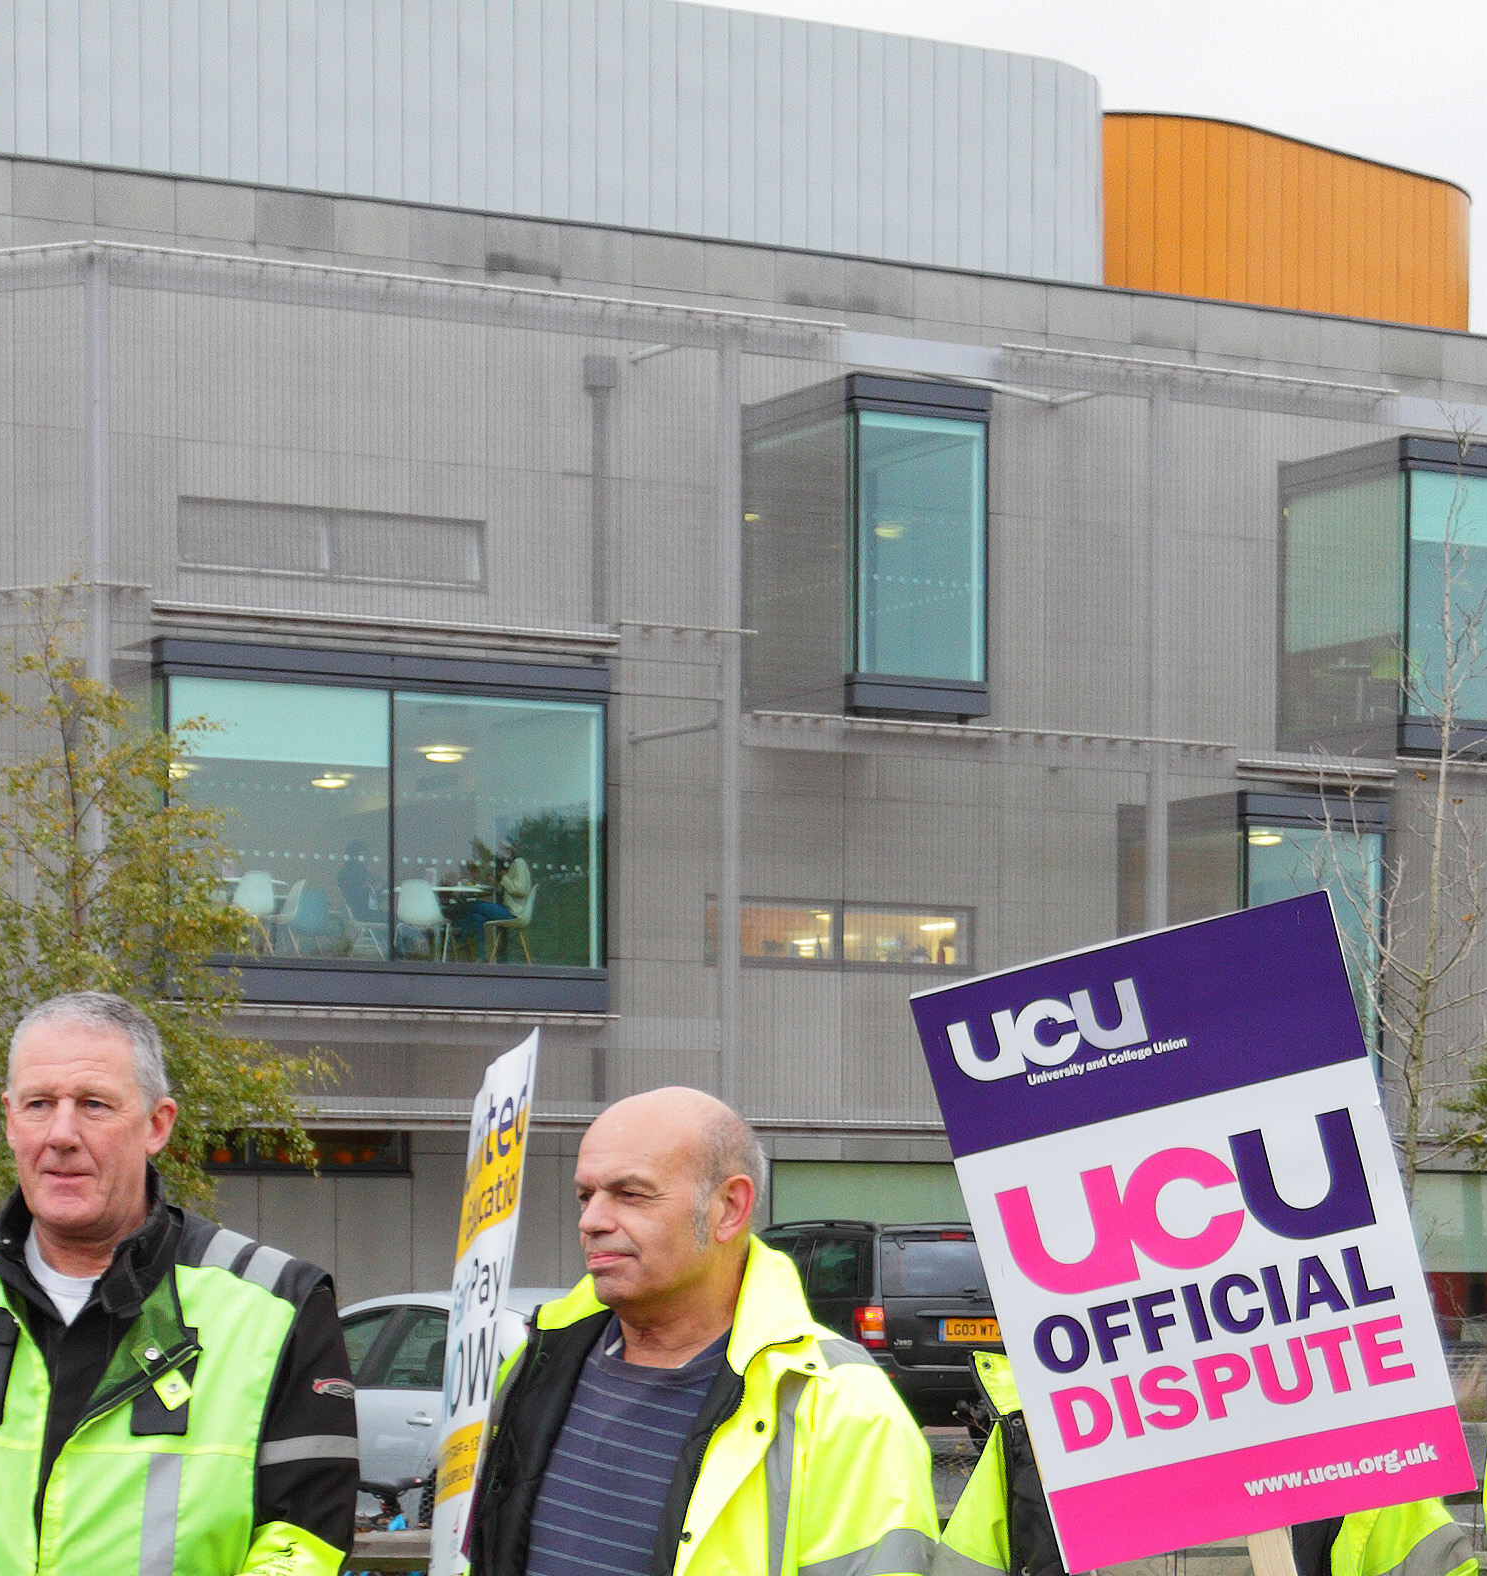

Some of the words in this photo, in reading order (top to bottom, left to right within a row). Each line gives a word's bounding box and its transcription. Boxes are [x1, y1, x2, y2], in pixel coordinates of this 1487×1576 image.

[947, 977, 1149, 1082] UCU
[1027, 1063, 1085, 1086] University
[1086, 1056, 1108, 1072] and
[1108, 1047, 1152, 1067] College
[1152, 1037, 1188, 1055] Union
[995, 1107, 1376, 1295] UCU
[946, 1324, 976, 1336] LG03
[1033, 1245, 1394, 1375] OFFICIAL
[1048, 1313, 1415, 1454] DISPUTE
[1244, 1441, 1438, 1498] www.ucu.org.uk
